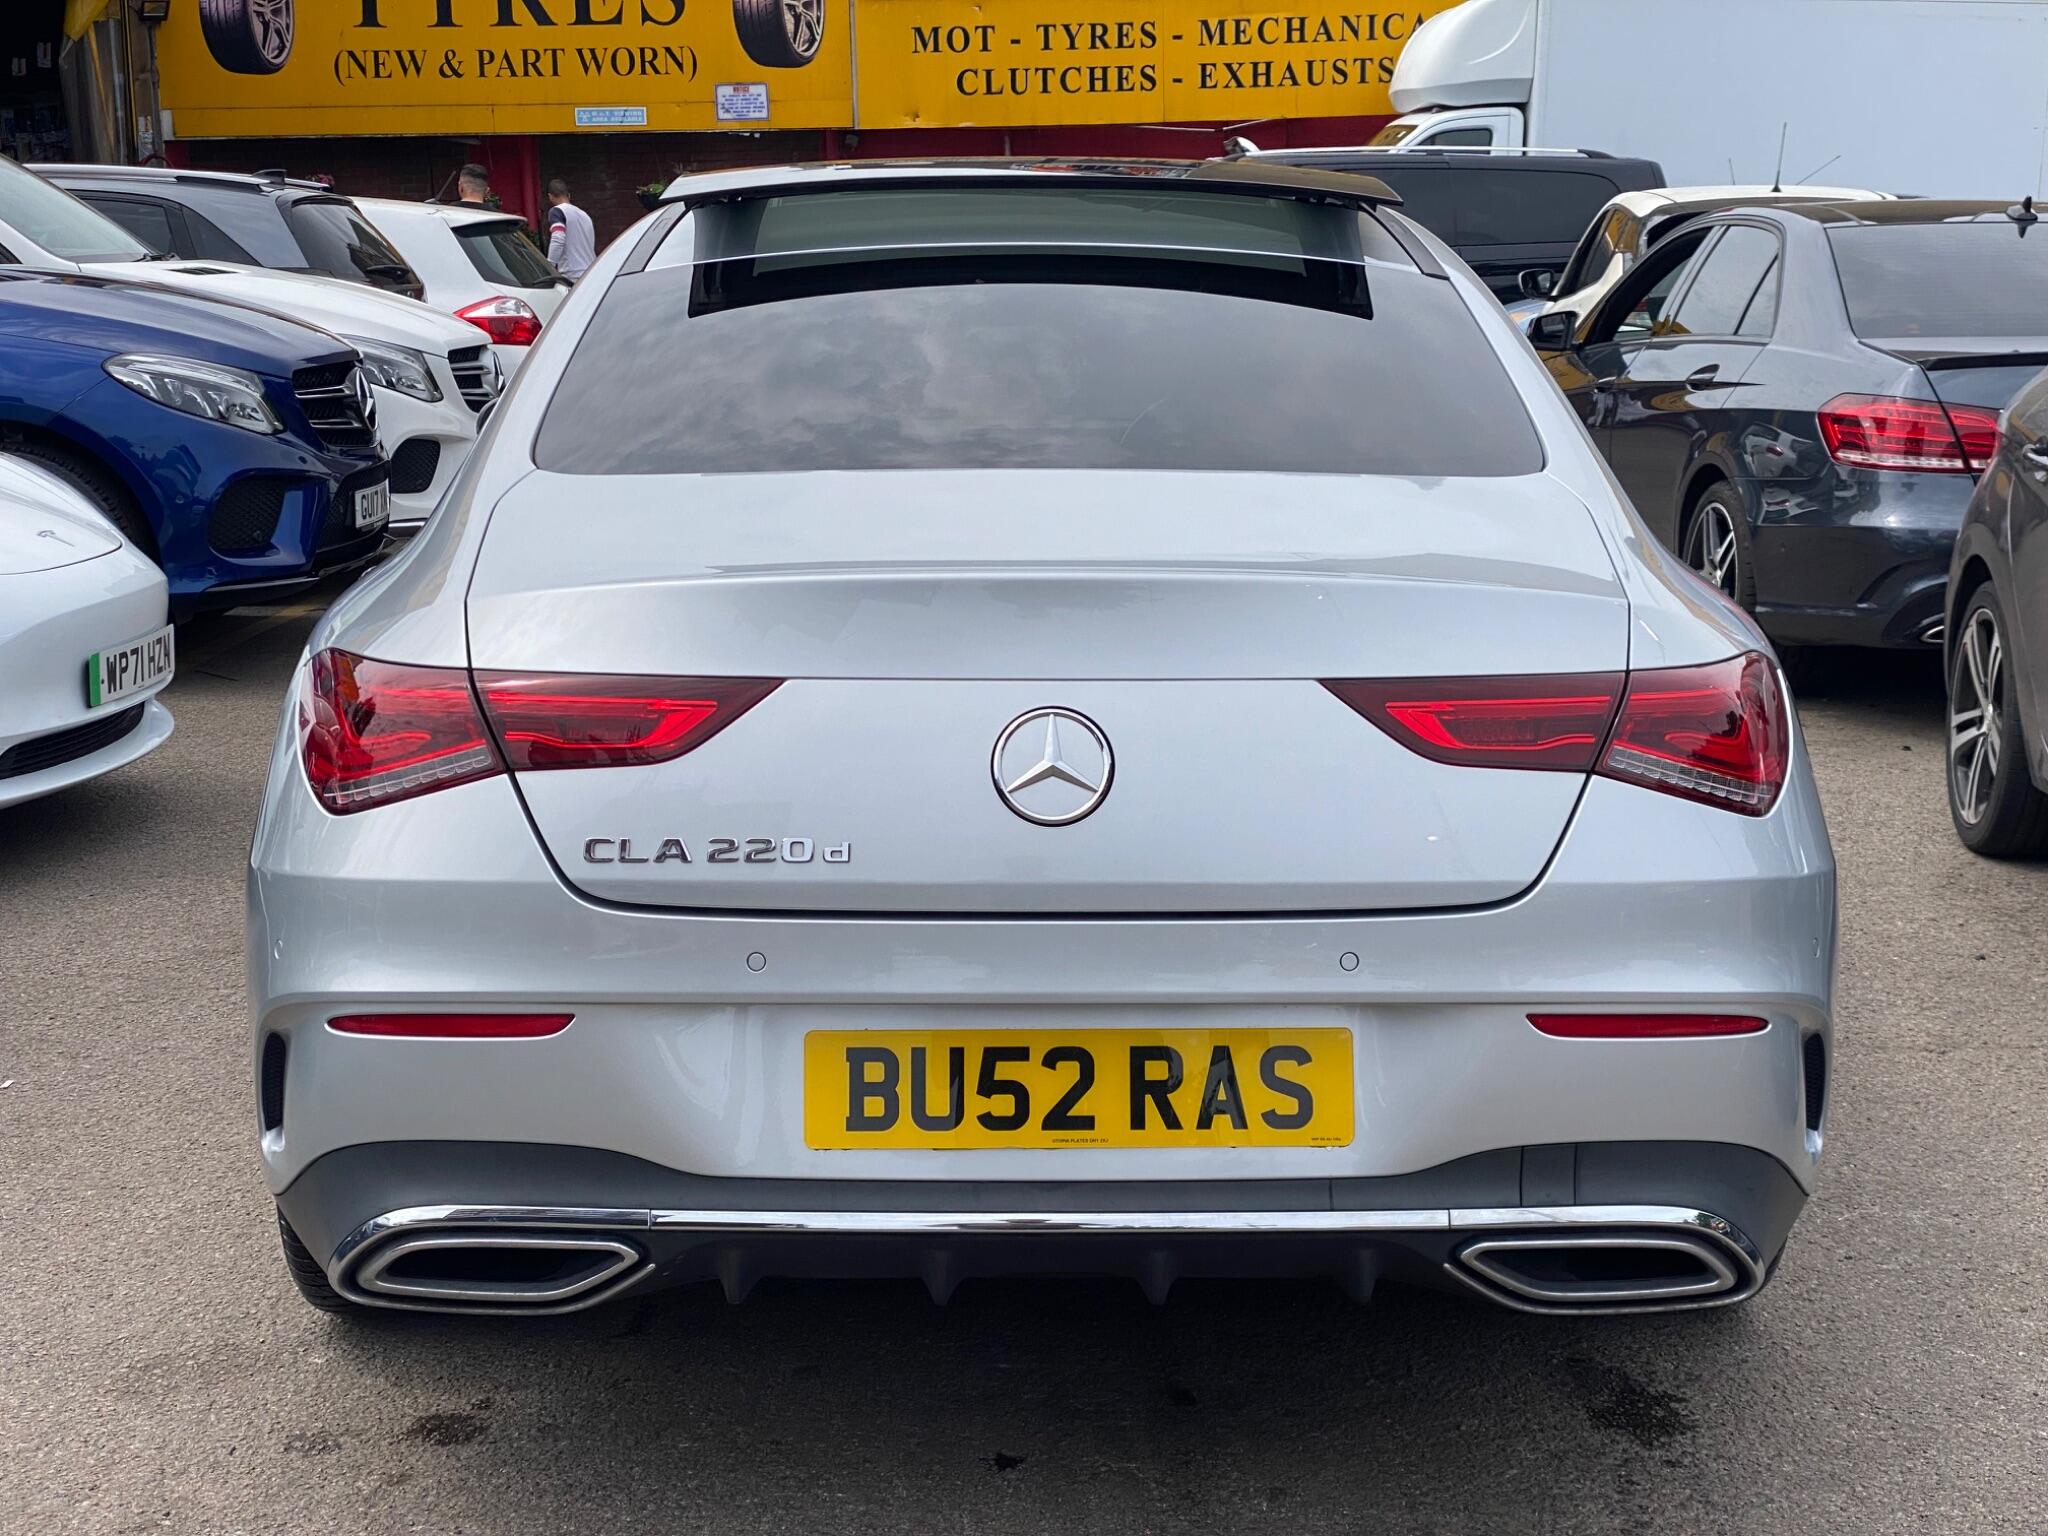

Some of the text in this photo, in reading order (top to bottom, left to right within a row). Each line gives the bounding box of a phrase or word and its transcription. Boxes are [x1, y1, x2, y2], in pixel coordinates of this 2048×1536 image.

[911, 25, 995, 53] MOT
[1036, 20, 1157, 51] TYRES
[334, 46, 698, 87] (NEW & PART WORN)
[956, 64, 1158, 95] CLUTCHES
[1198, 56, 1394, 89] EXHAUSTS
[106, 633, 171, 694] WP71 HZN
[583, 837, 653, 863] CLA
[845, 1044, 1314, 1132] BU52 RAS
